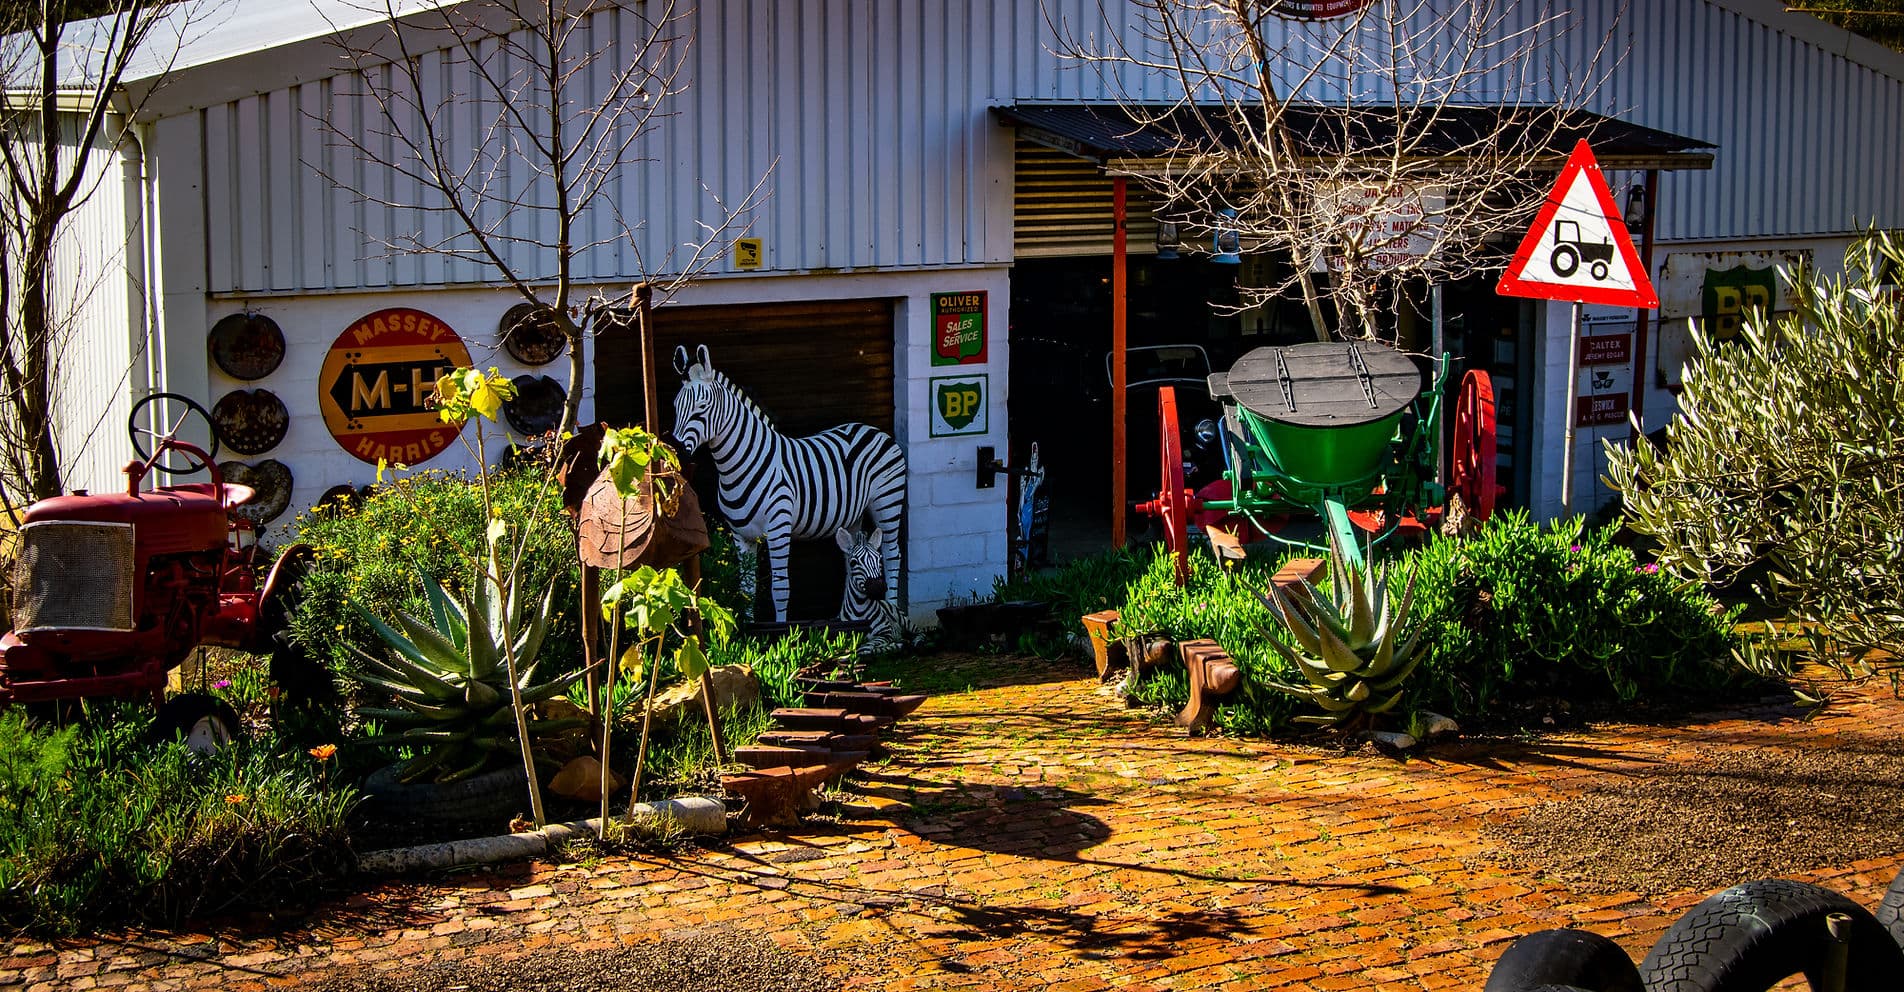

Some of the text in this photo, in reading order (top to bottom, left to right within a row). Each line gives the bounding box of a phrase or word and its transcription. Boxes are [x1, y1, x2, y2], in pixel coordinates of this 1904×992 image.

[1364, 184, 1404, 198] DAER
[1391, 220, 1429, 232] MATCES
[1368, 237, 1409, 250] LITERS
[1376, 253, 1425, 266] PROHIB
[940, 295, 980, 307] OLIVER
[353, 314, 446, 345] MASSEY
[946, 319, 973, 333] SALES
[943, 331, 979, 347] SERVICE
[1590, 340, 1621, 350] CALTEX
[351, 367, 444, 411] M-H
[944, 390, 978, 418] BP
[356, 431, 445, 463] HARRIS
